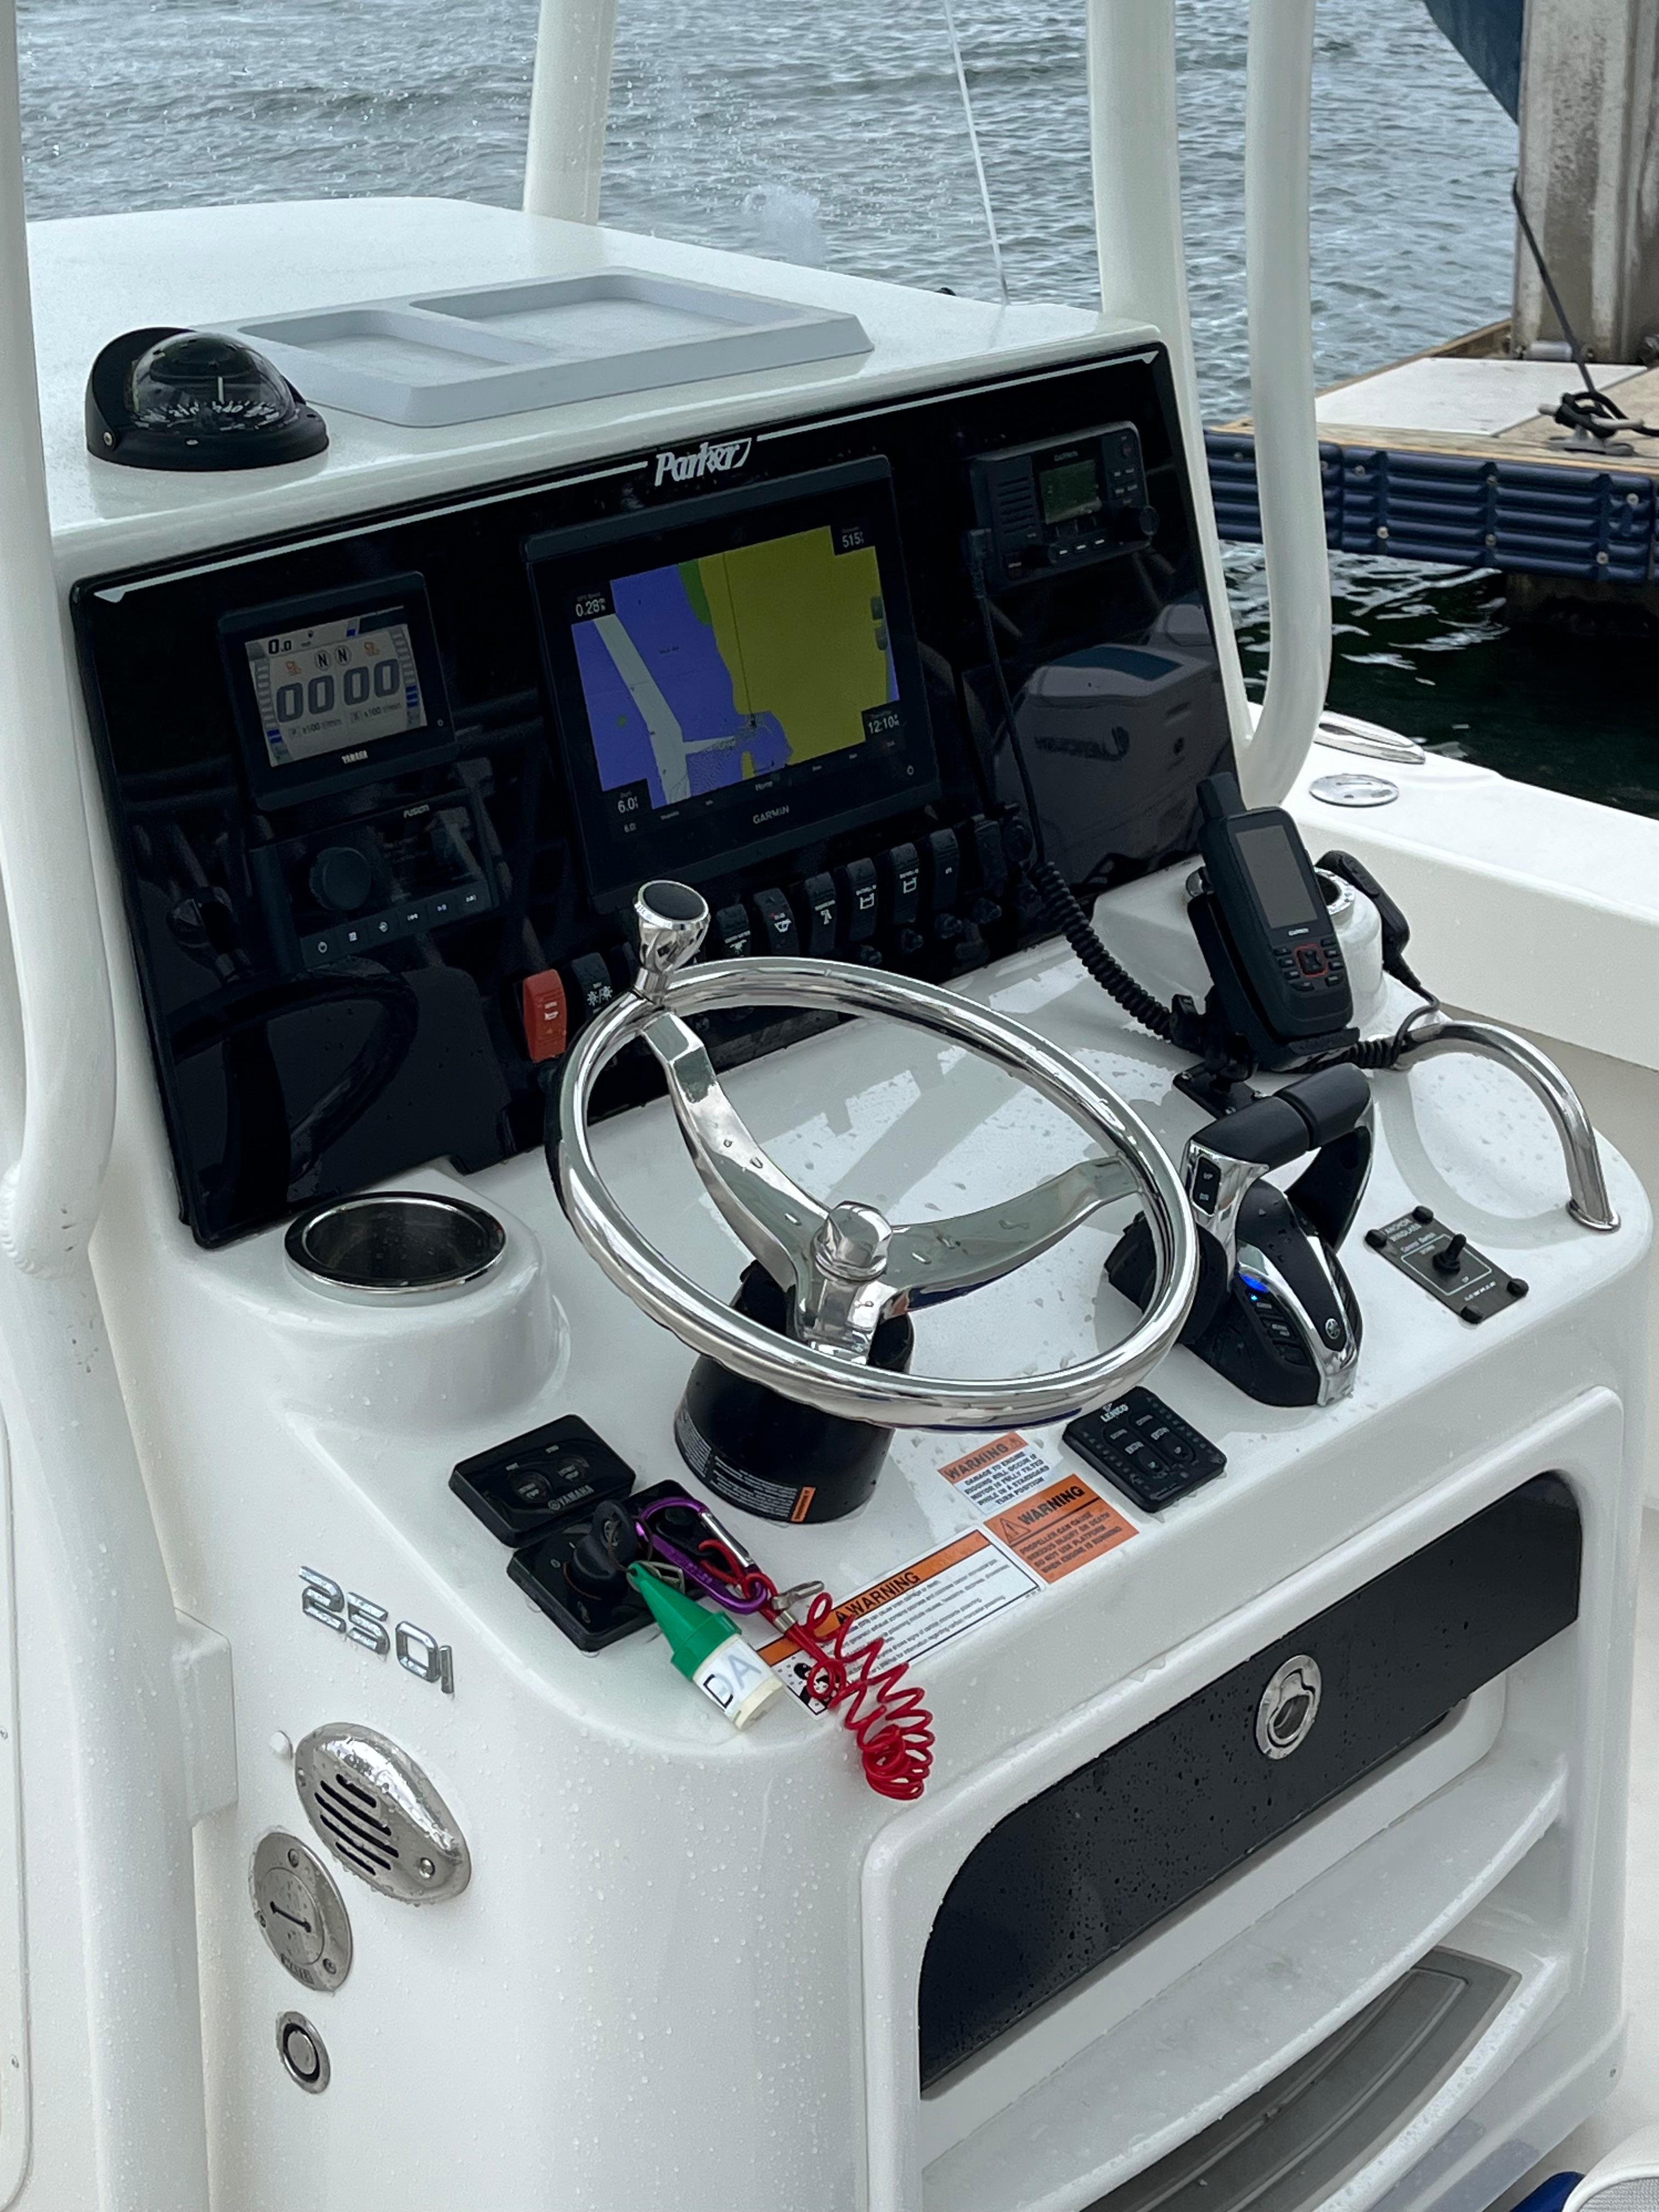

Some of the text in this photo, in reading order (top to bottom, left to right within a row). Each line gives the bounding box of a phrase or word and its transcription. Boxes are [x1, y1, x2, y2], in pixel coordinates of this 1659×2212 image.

[654, 438, 752, 487] Parker
[842, 532, 861, 548] 515
[575, 599, 600, 617] 0.28
[318, 648, 347, 667] N N
[753, 805, 789, 825] GARMIN
[943, 1442, 1010, 1480] WARNING
[557, 1485, 595, 1507] YAMAHA
[1015, 1484, 1086, 1526] WARNING
[1055, 1523, 1072, 1534] CAN
[845, 1570, 922, 1617] WARNING
